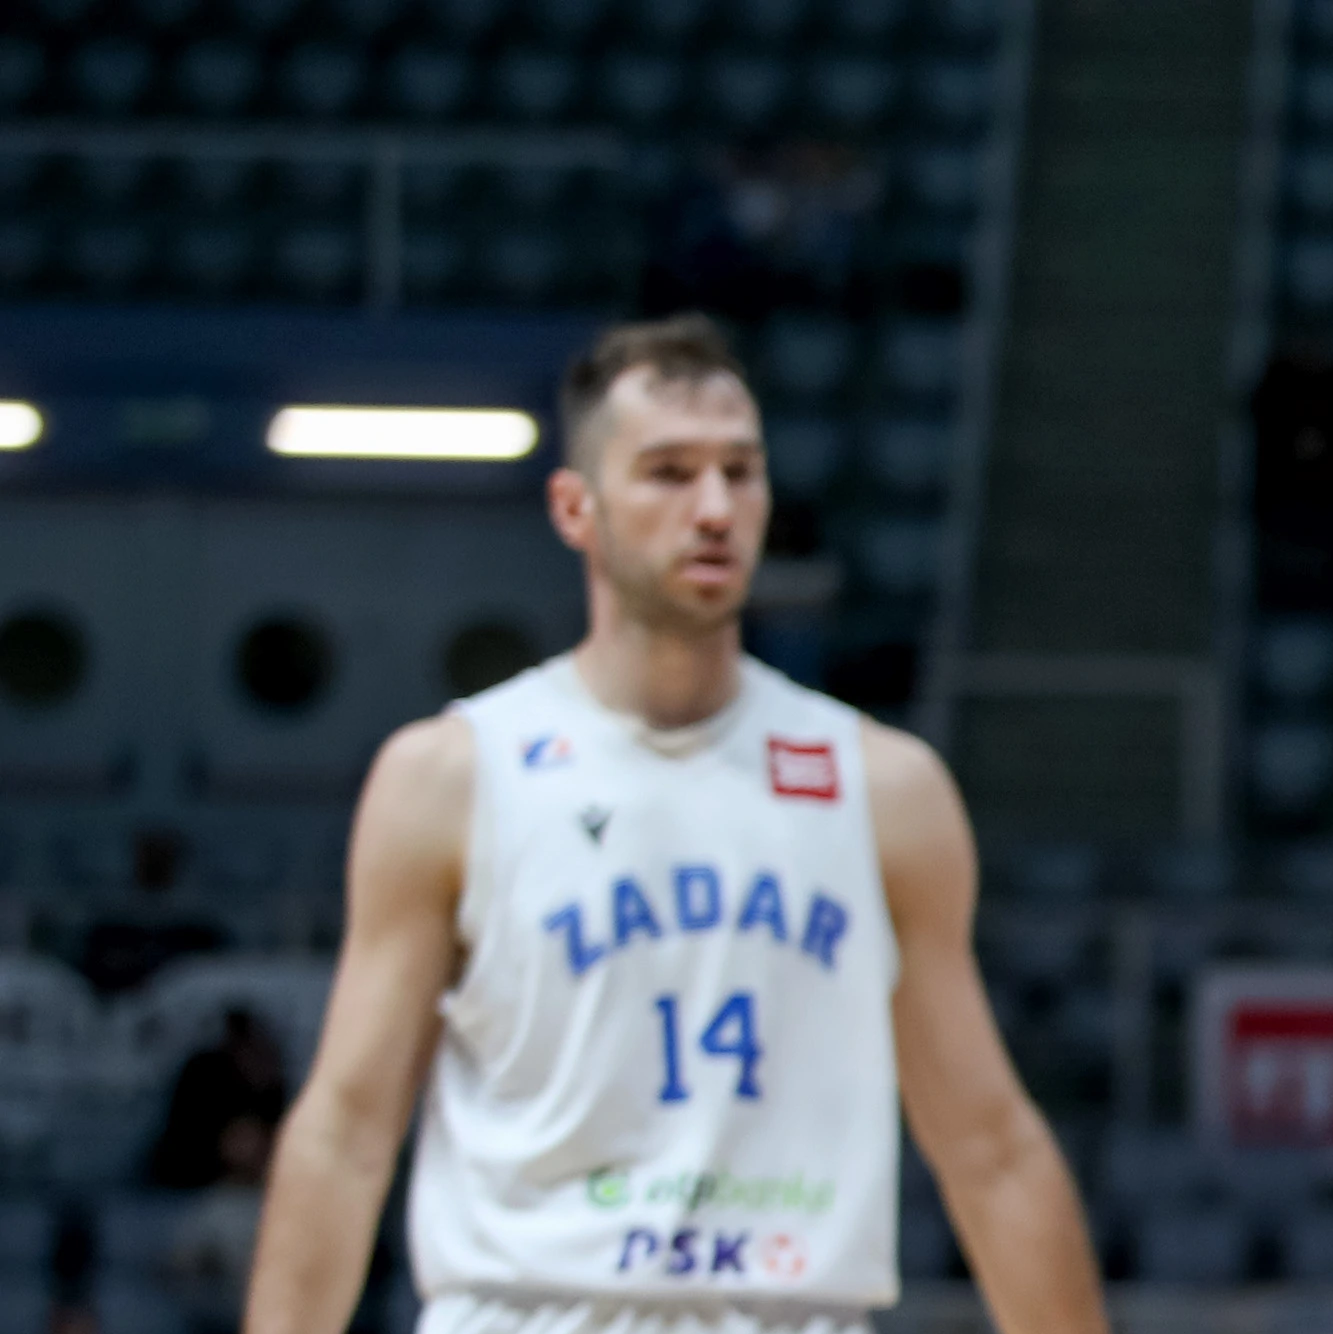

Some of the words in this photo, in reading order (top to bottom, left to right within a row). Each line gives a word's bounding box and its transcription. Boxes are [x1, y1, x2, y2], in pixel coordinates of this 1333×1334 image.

[543, 864, 850, 974] ZADAR
[653, 991, 764, 1102] 14
[616, 1226, 754, 1276] PSK
